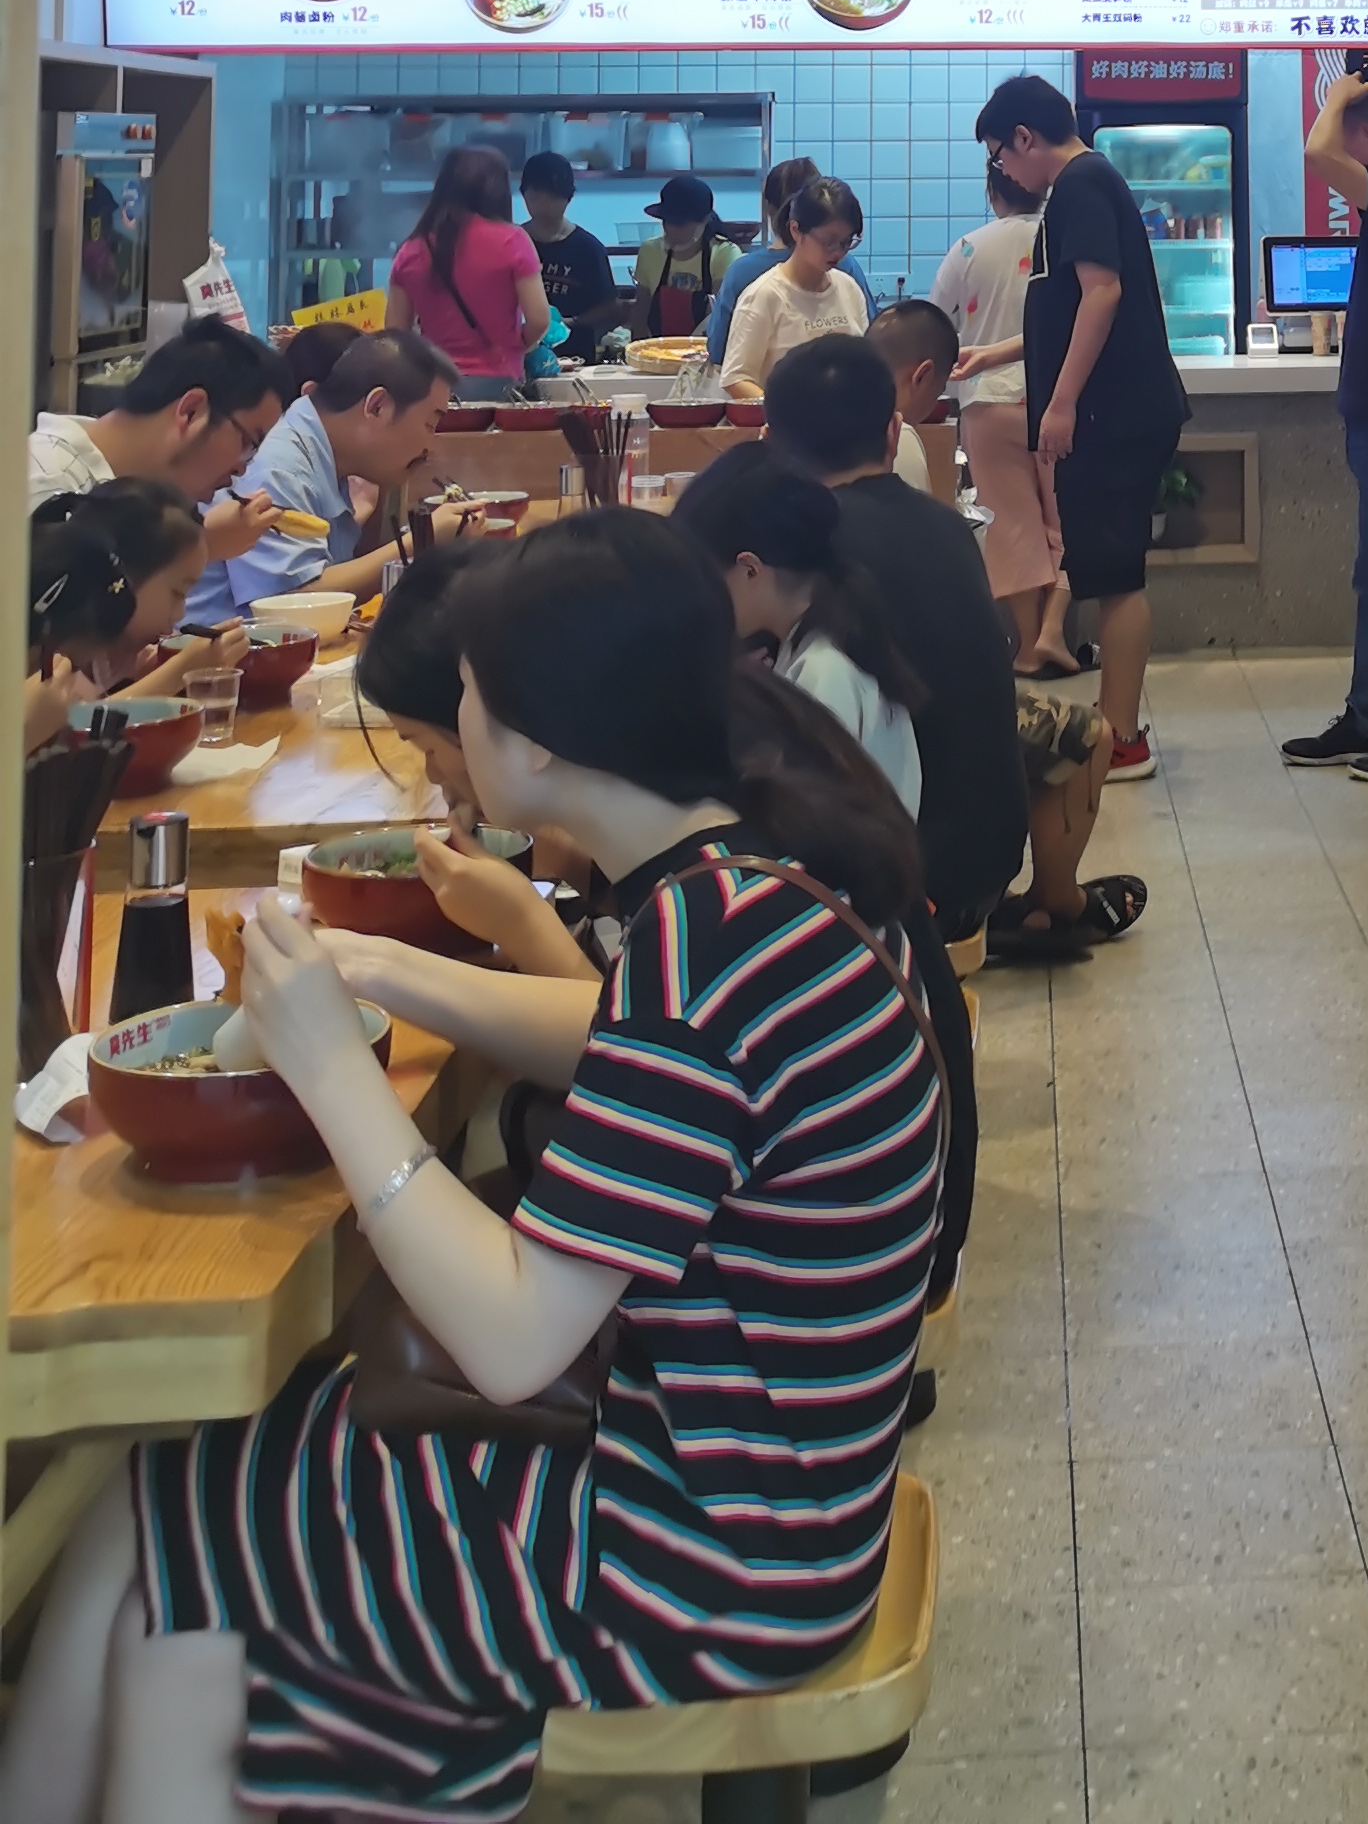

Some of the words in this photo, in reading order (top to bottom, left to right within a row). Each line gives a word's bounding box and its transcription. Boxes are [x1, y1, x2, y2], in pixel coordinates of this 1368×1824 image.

[1091, 60, 1234, 79] 好肉好油好汤底!
[804, 316, 849, 330] FLOWERS
